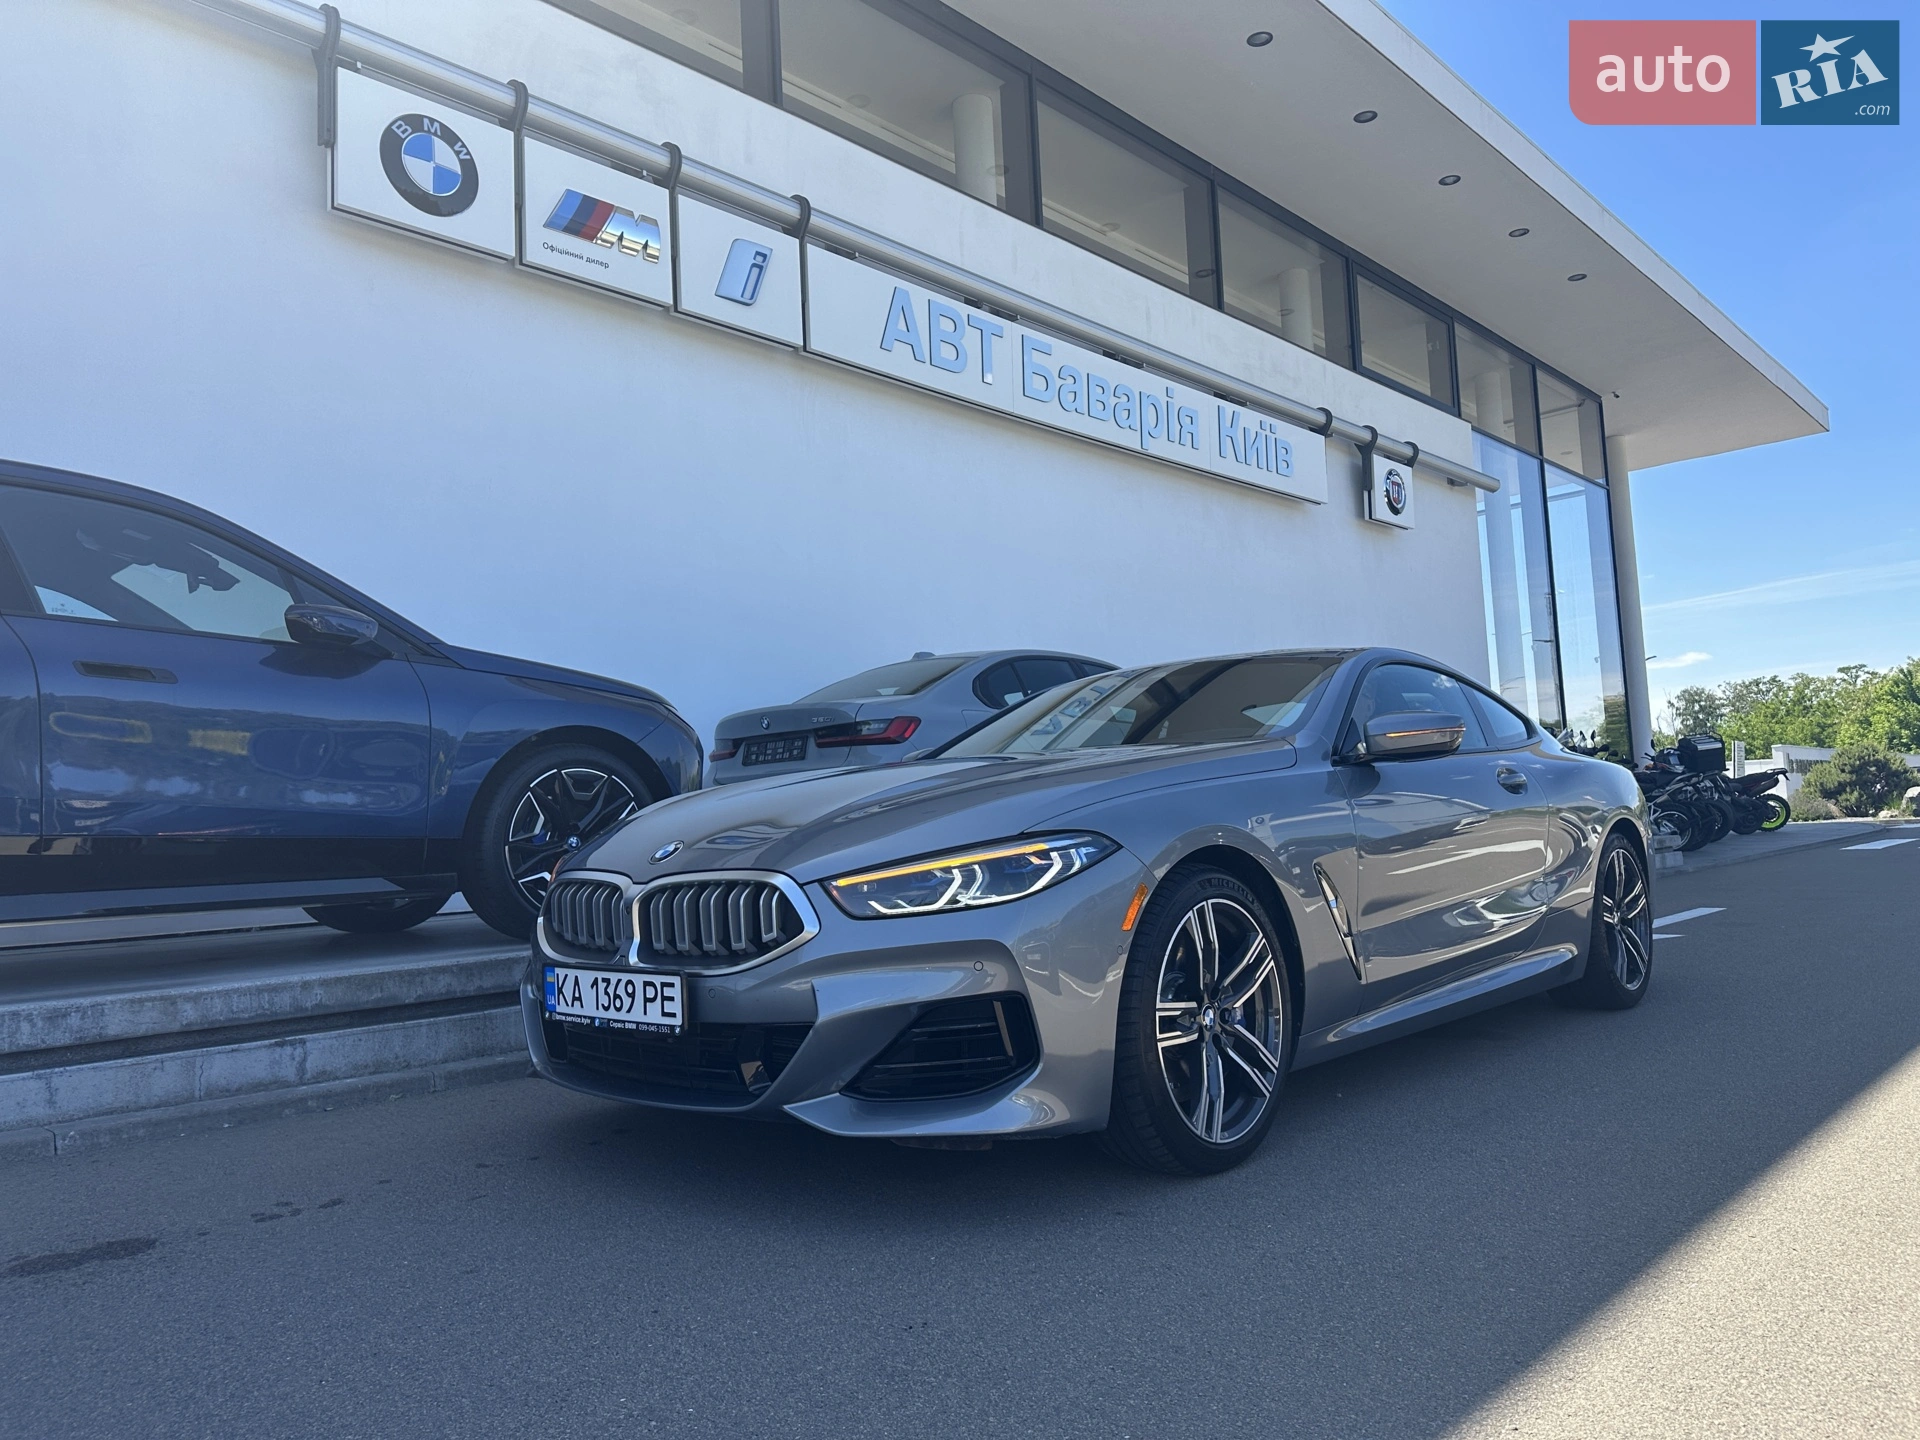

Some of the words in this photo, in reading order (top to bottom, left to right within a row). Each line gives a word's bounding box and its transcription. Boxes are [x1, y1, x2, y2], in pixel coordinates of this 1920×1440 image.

[391, 117, 471, 160] BMW
[542, 241, 584, 261] Офіційний
[585, 256, 610, 270] дилер
[879, 286, 1004, 385] АВТ
[1021, 333, 1200, 450] Баварія
[1217, 404, 1295, 478] Київ
[547, 994, 556, 1005] UA
[556, 973, 584, 1009] KA
[590, 976, 636, 1014] 1369
[642, 980, 677, 1018] PE
